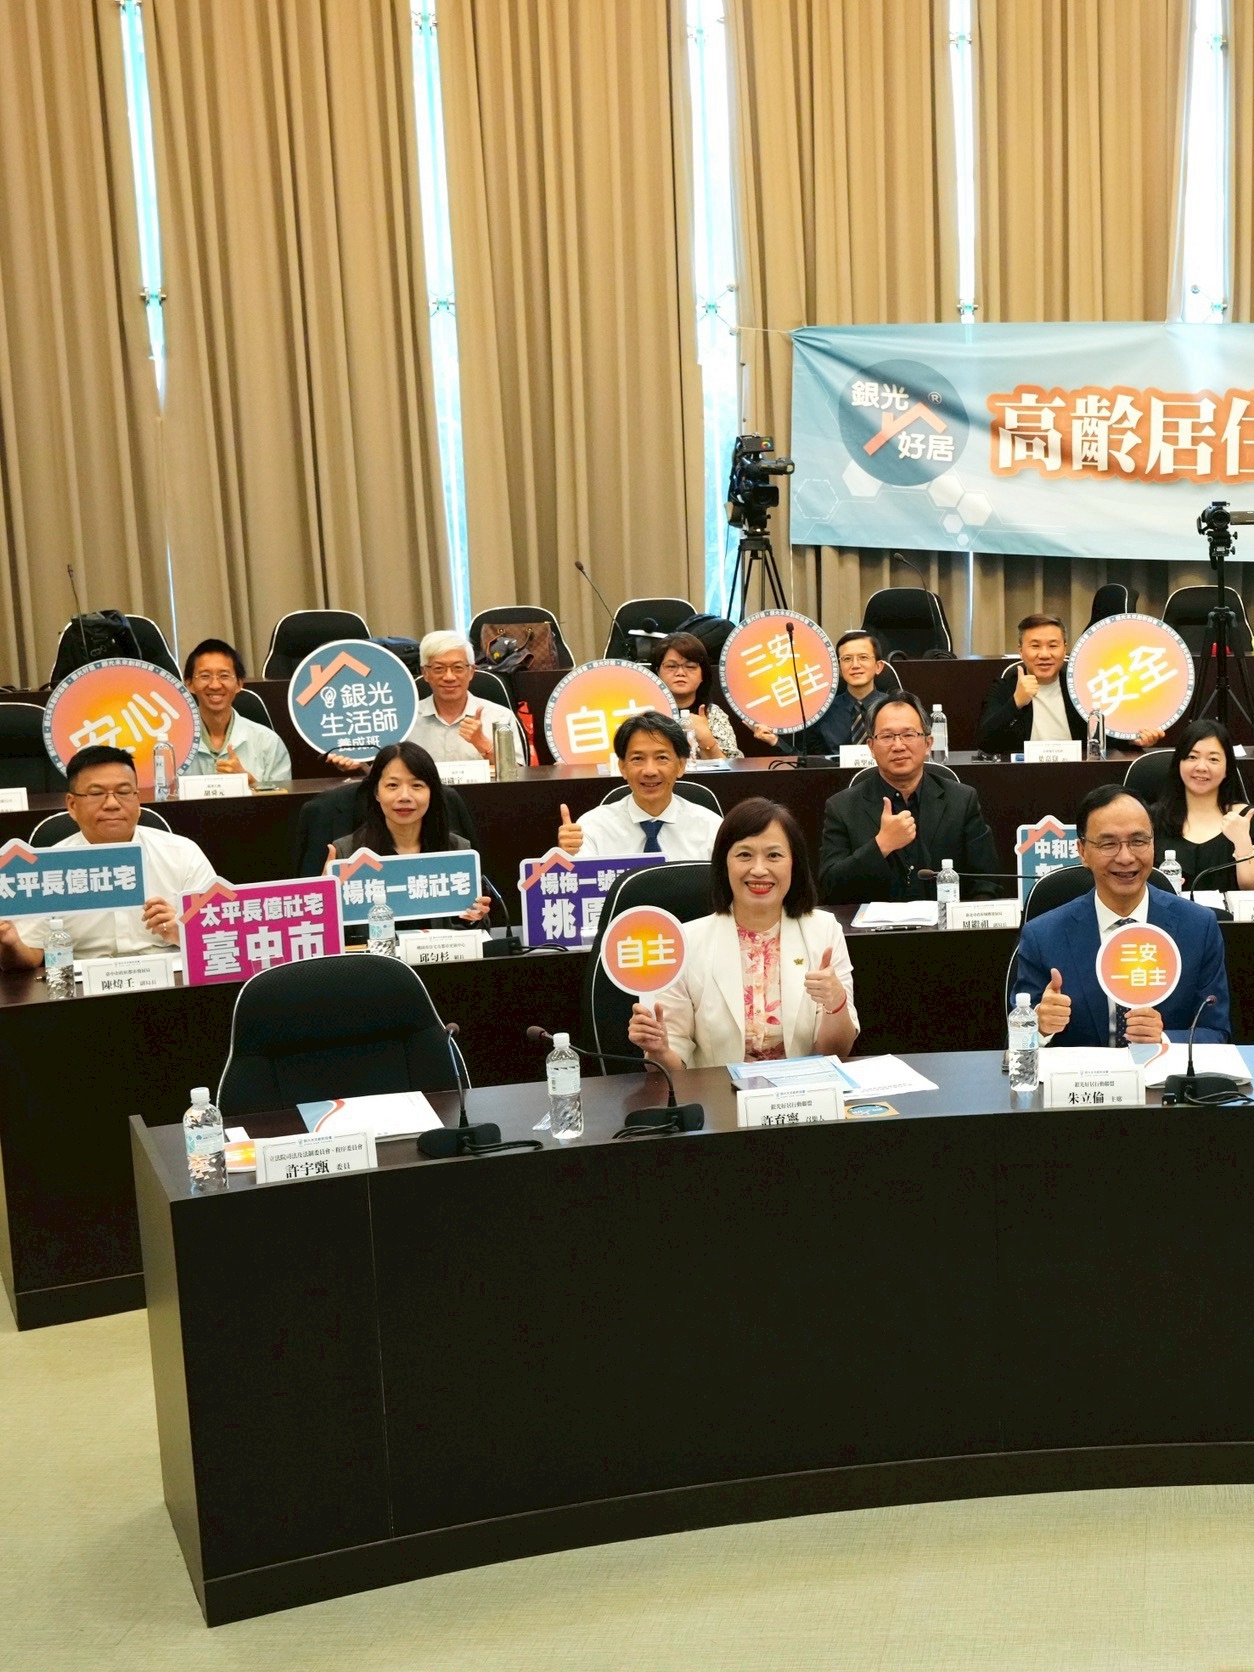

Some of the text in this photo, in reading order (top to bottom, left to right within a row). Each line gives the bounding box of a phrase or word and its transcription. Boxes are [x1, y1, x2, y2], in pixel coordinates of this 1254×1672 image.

[851, 380, 909, 409] 銀光
[898, 431, 955, 462] 好居
[741, 633, 801, 678] 三安
[340, 682, 394, 708] 銀光
[745, 664, 829, 709] 一自主
[1086, 645, 1178, 717] 安全
[69, 691, 180, 753] 安心
[321, 708, 398, 737] 生活師
[0, 865, 136, 899] 太平長億社宅
[342, 871, 471, 905] 楊梅一號社宅
[540, 868, 631, 895] 楊梅一號
[200, 893, 324, 927] 太平長億社宅
[202, 921, 324, 976] 臺中市
[617, 934, 676, 968] 自主
[1120, 942, 1157, 964] 三安
[1111, 967, 1167, 987] 一自主
[1068, 1091, 1104, 1104] 朱立倫
